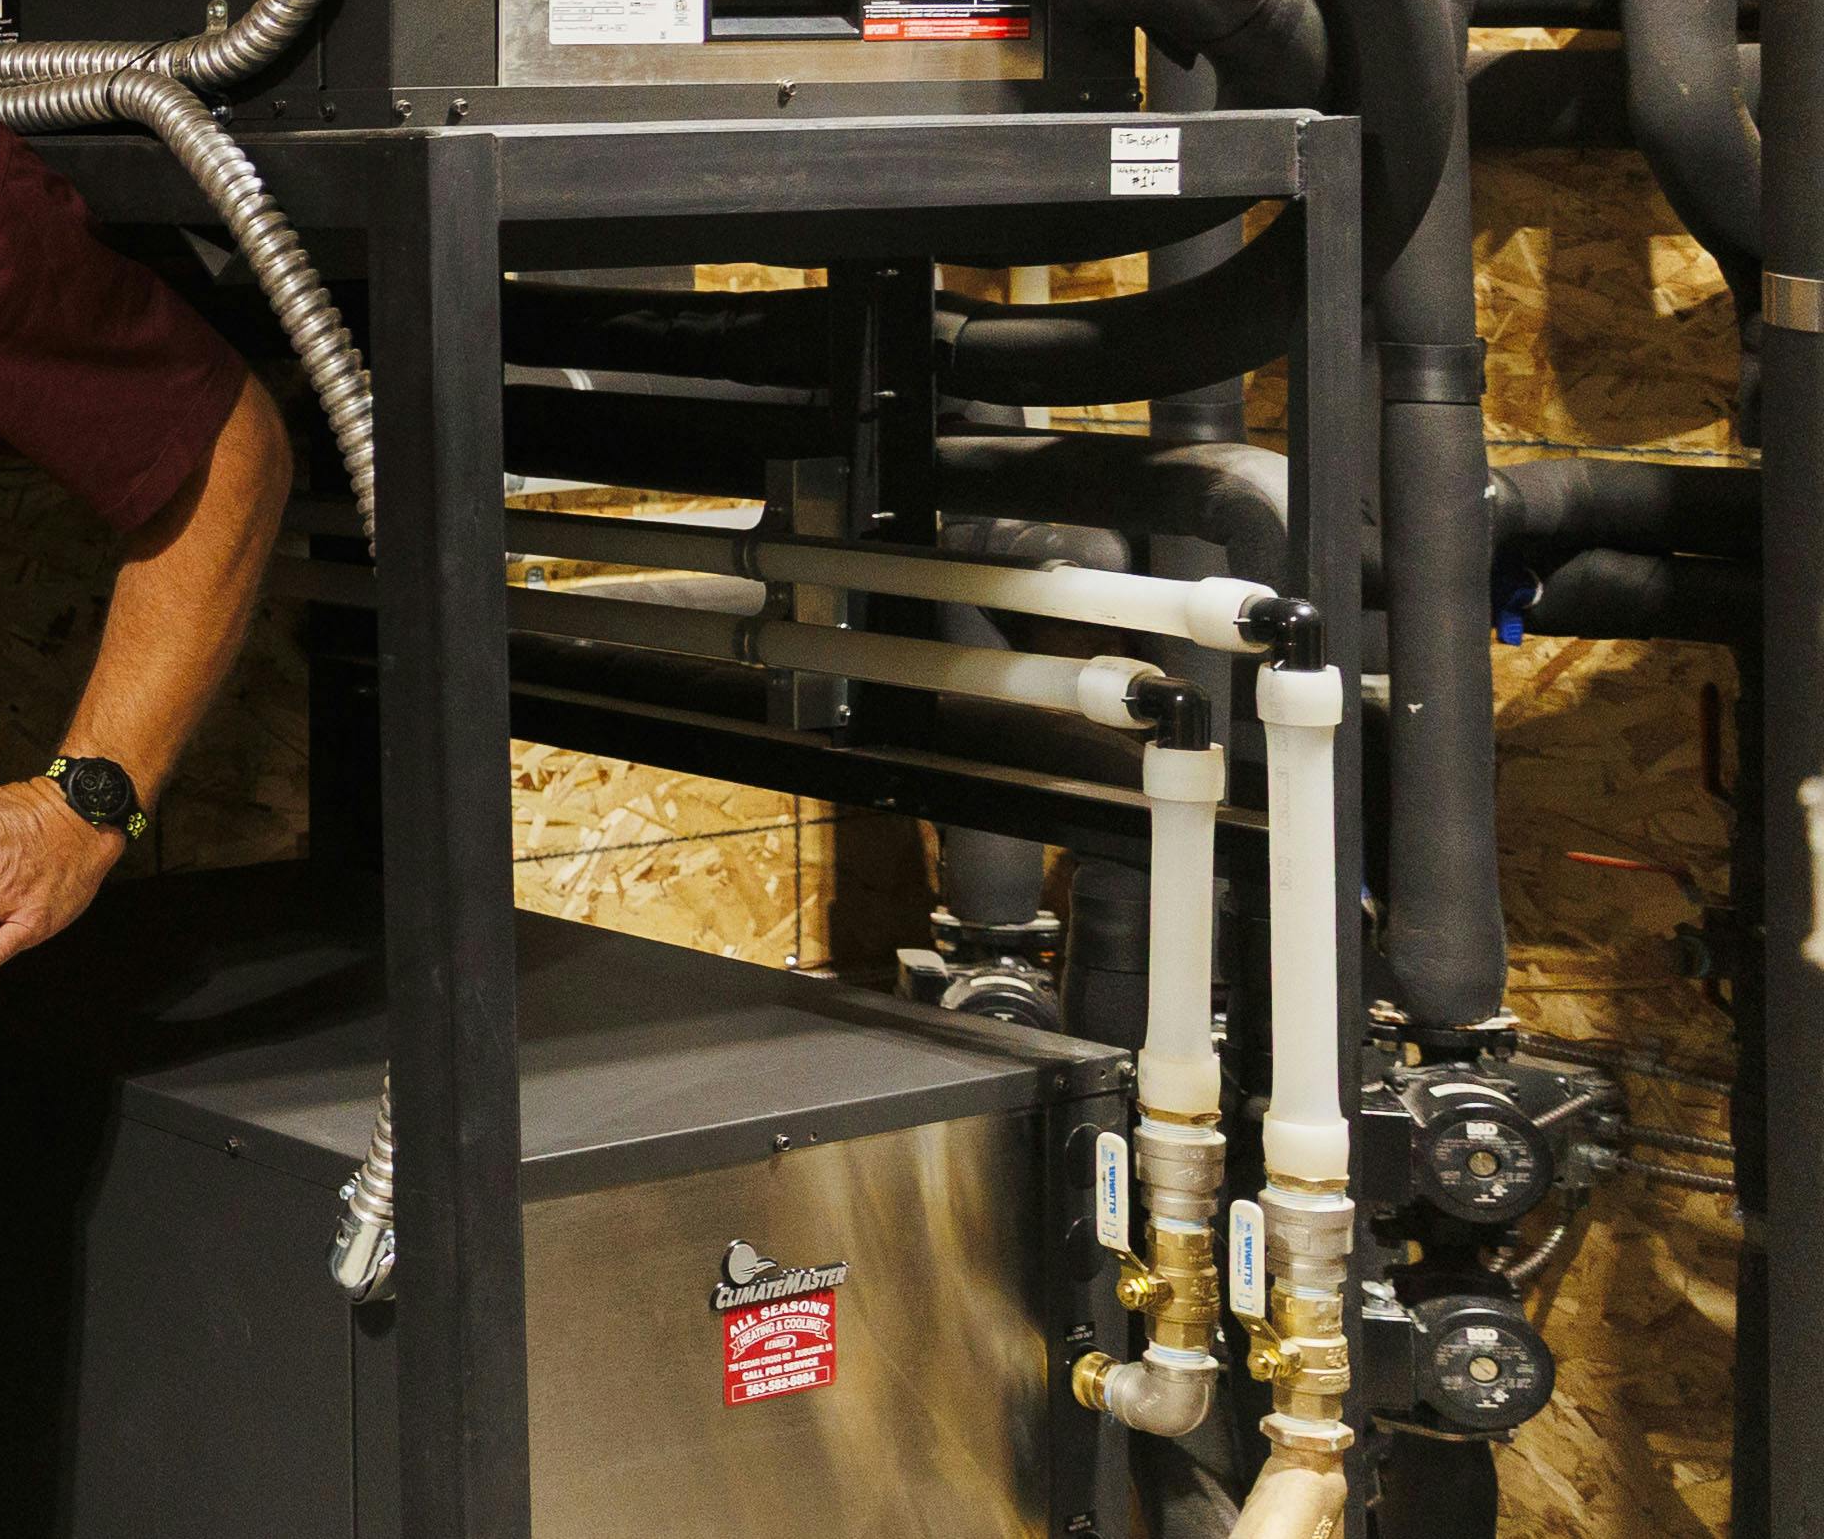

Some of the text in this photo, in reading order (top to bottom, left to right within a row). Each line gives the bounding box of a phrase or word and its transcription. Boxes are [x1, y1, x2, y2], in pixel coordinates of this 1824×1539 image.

[1109, 1165, 1117, 1215] WATTS
[1244, 1236, 1253, 1286] WATTS
[729, 1301, 829, 1338] ALL SEASONS
[738, 1319, 821, 1347] HEATING & COOLING
[742, 1357, 819, 1382] CALL FOR SERVICE
